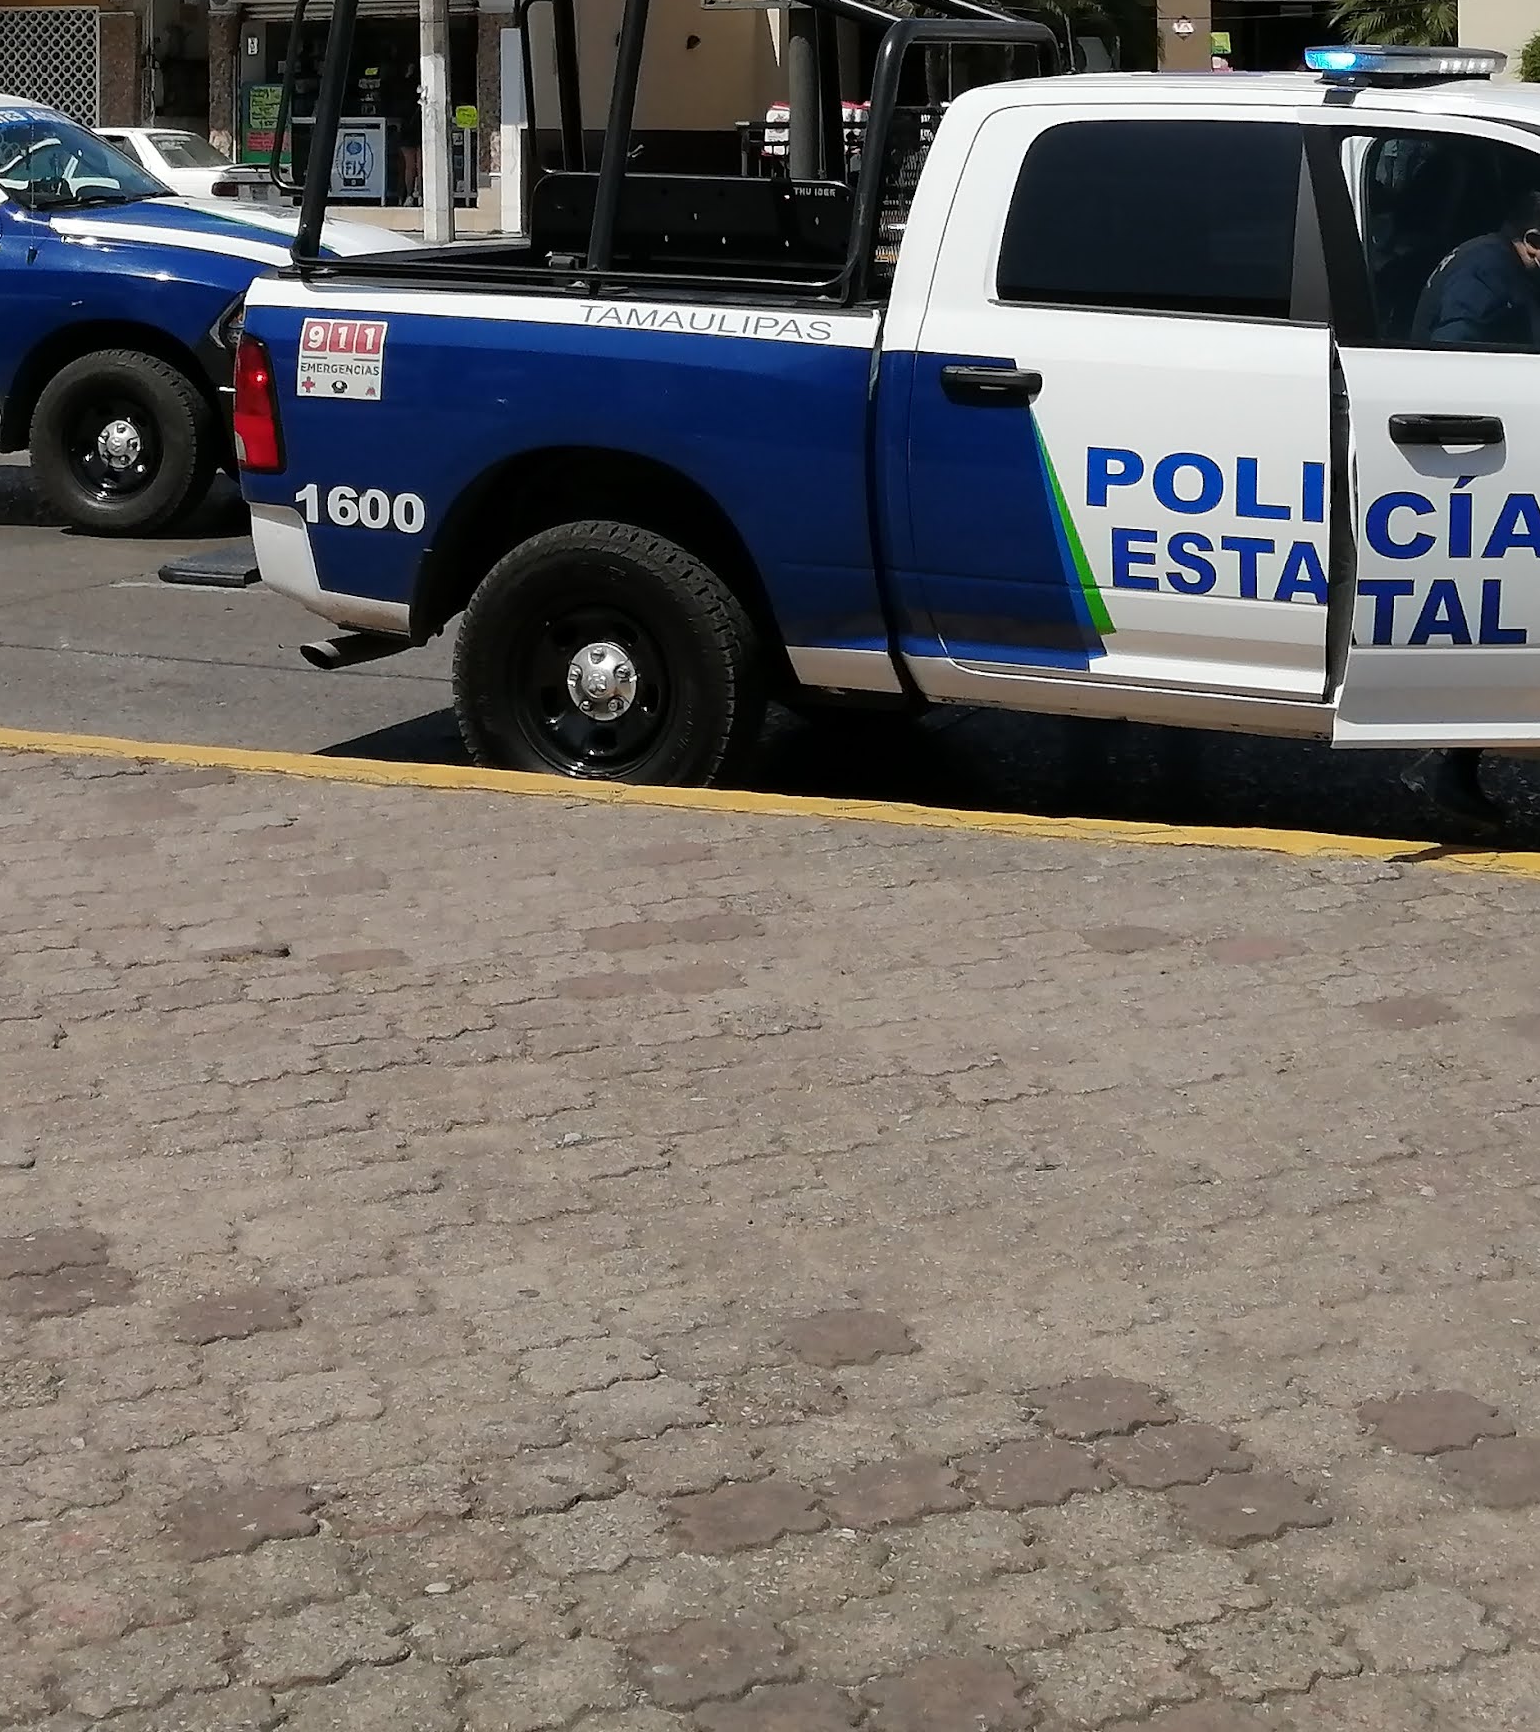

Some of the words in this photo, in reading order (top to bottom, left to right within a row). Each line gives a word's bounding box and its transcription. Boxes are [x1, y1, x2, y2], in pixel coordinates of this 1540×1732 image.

[309, 325, 376, 351] 911
[580, 305, 832, 341] TAMAULIPAS
[301, 362, 380, 377] EMERGENCIAS
[294, 483, 426, 534] 1600
[1112, 527, 1527, 646] ESTATAL
